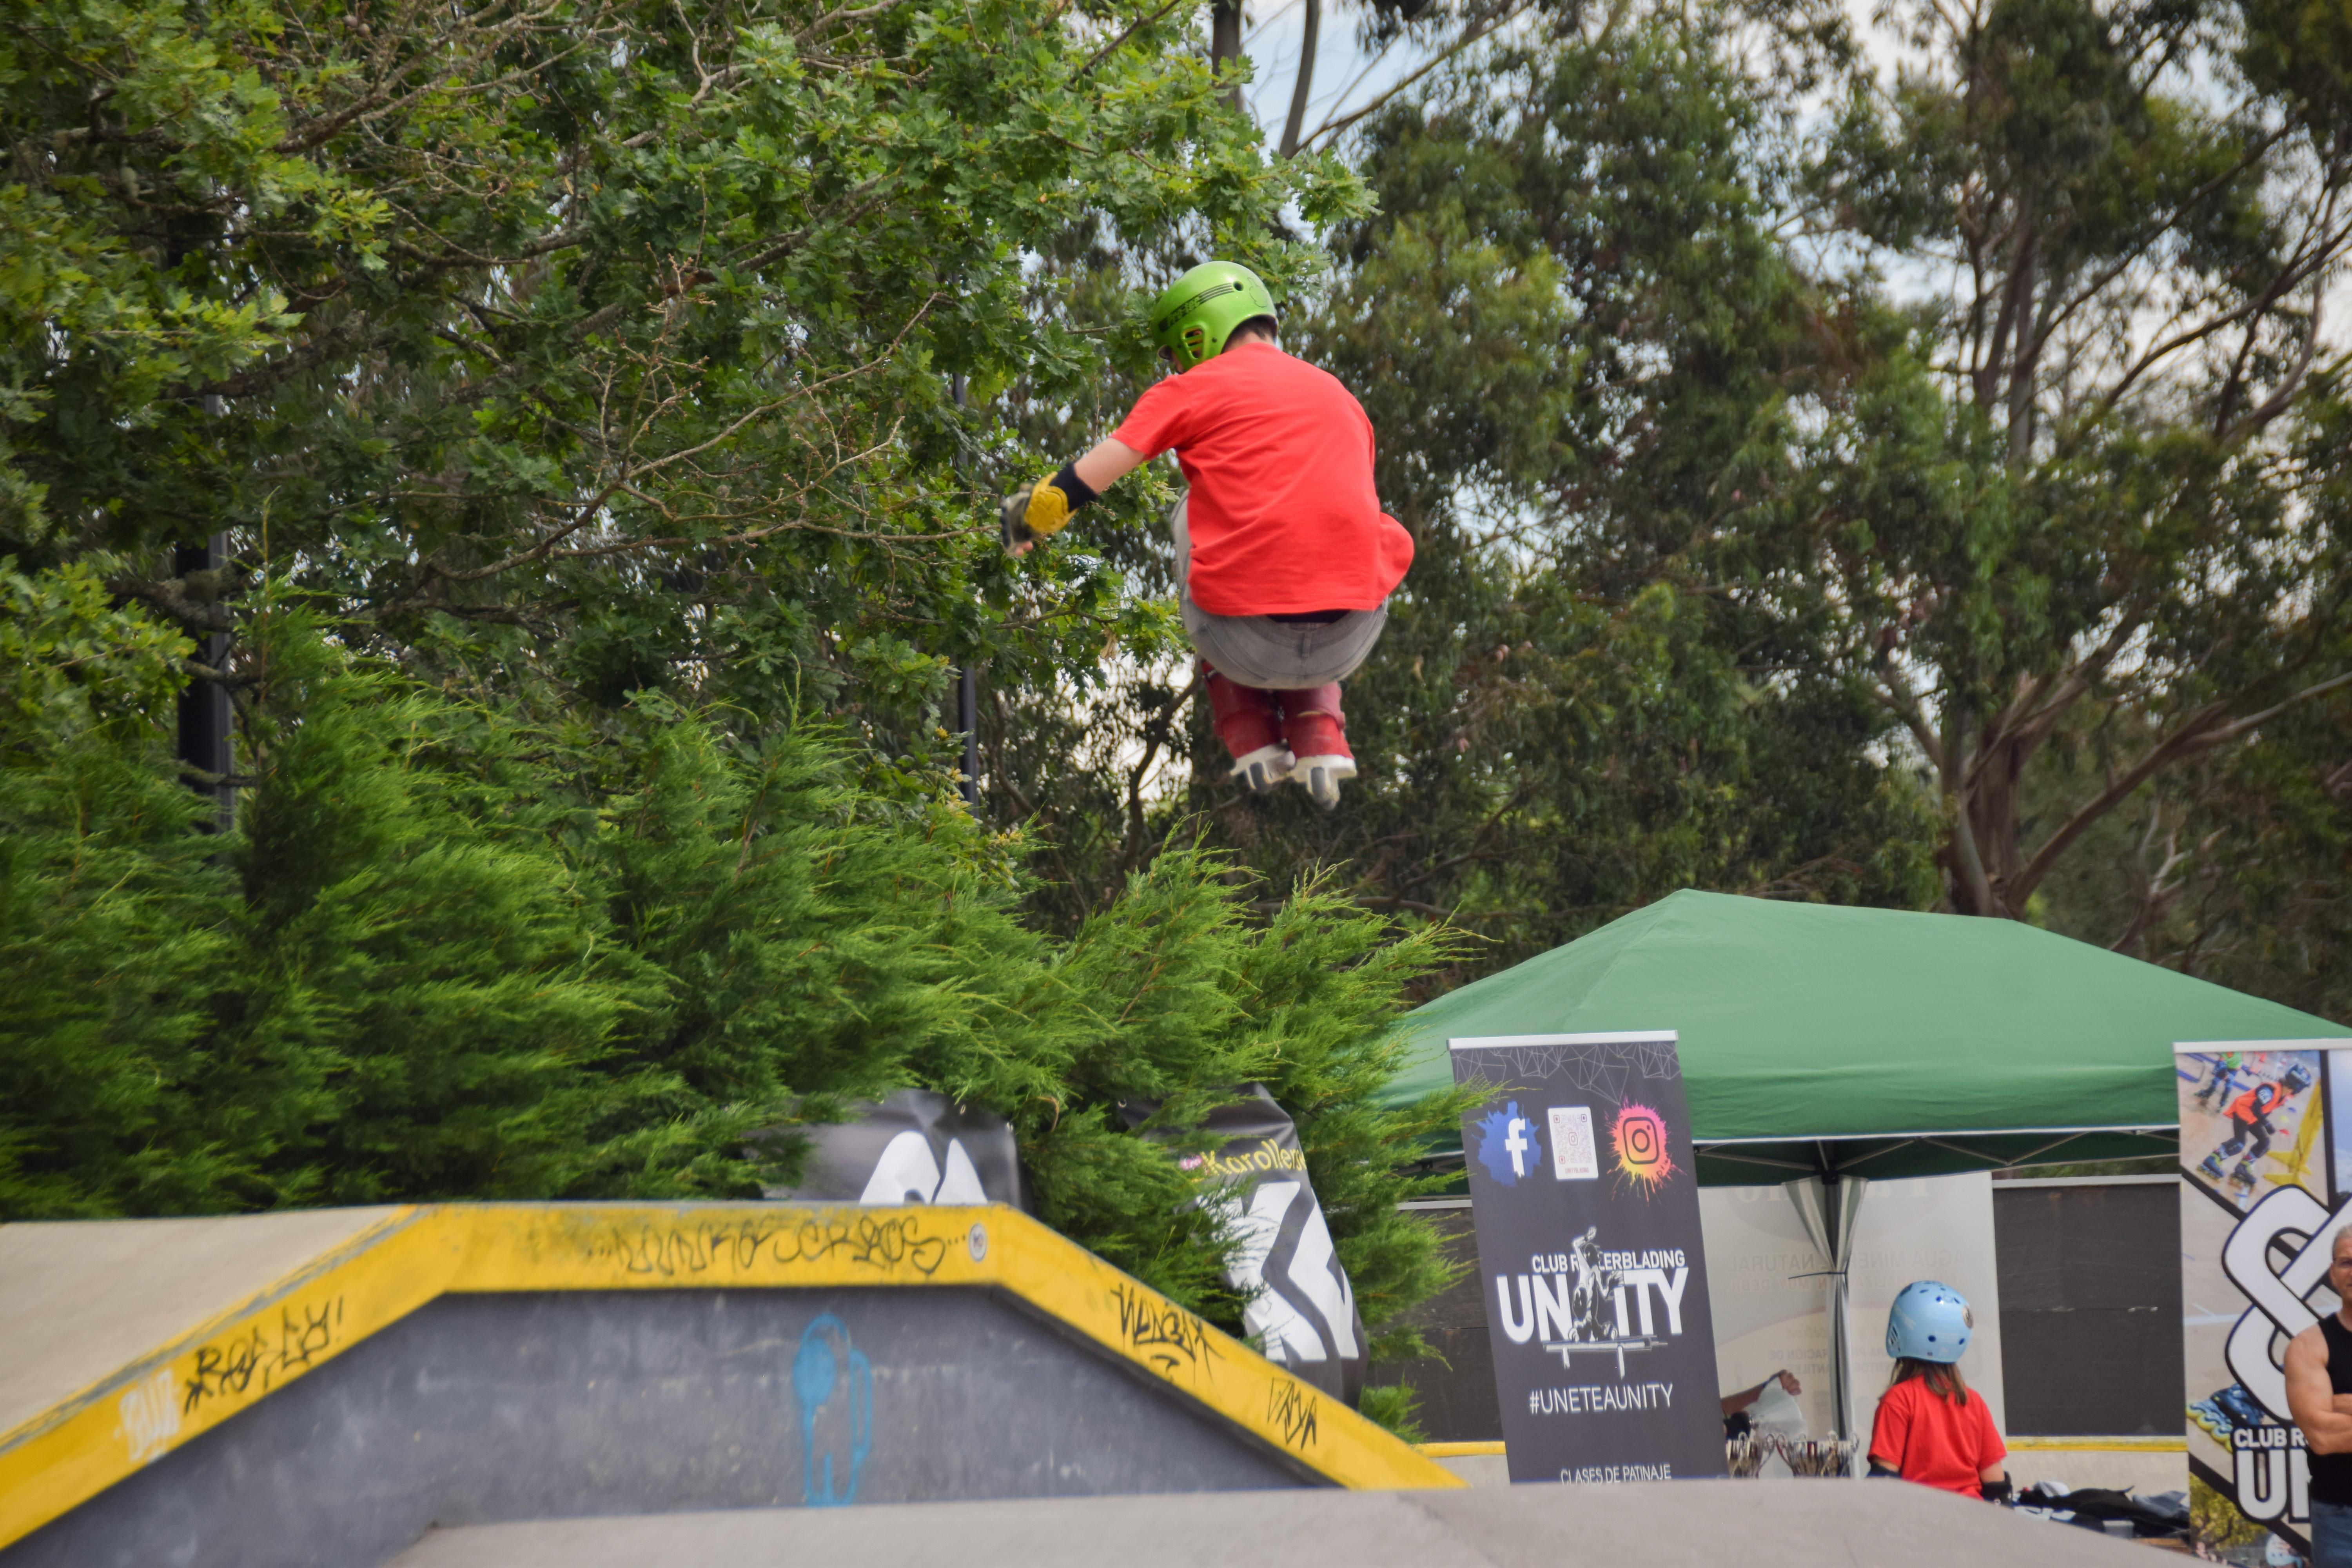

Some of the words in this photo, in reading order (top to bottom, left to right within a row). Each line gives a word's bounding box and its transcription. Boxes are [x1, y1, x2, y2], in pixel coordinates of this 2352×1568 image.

[1532, 1254, 1568, 1273] CLUB
[1570, 1250, 1685, 1273] RLERBLADING
[1497, 1267, 1689, 1344] UNITY
[1530, 1383, 1673, 1414] #UNETEAUNITY
[2234, 1427, 2287, 1448] CLUB
[1561, 1468, 1603, 1486] CLASES
[1605, 1466, 1621, 1484] DE
[1623, 1463, 1672, 1482] PATINAJE
